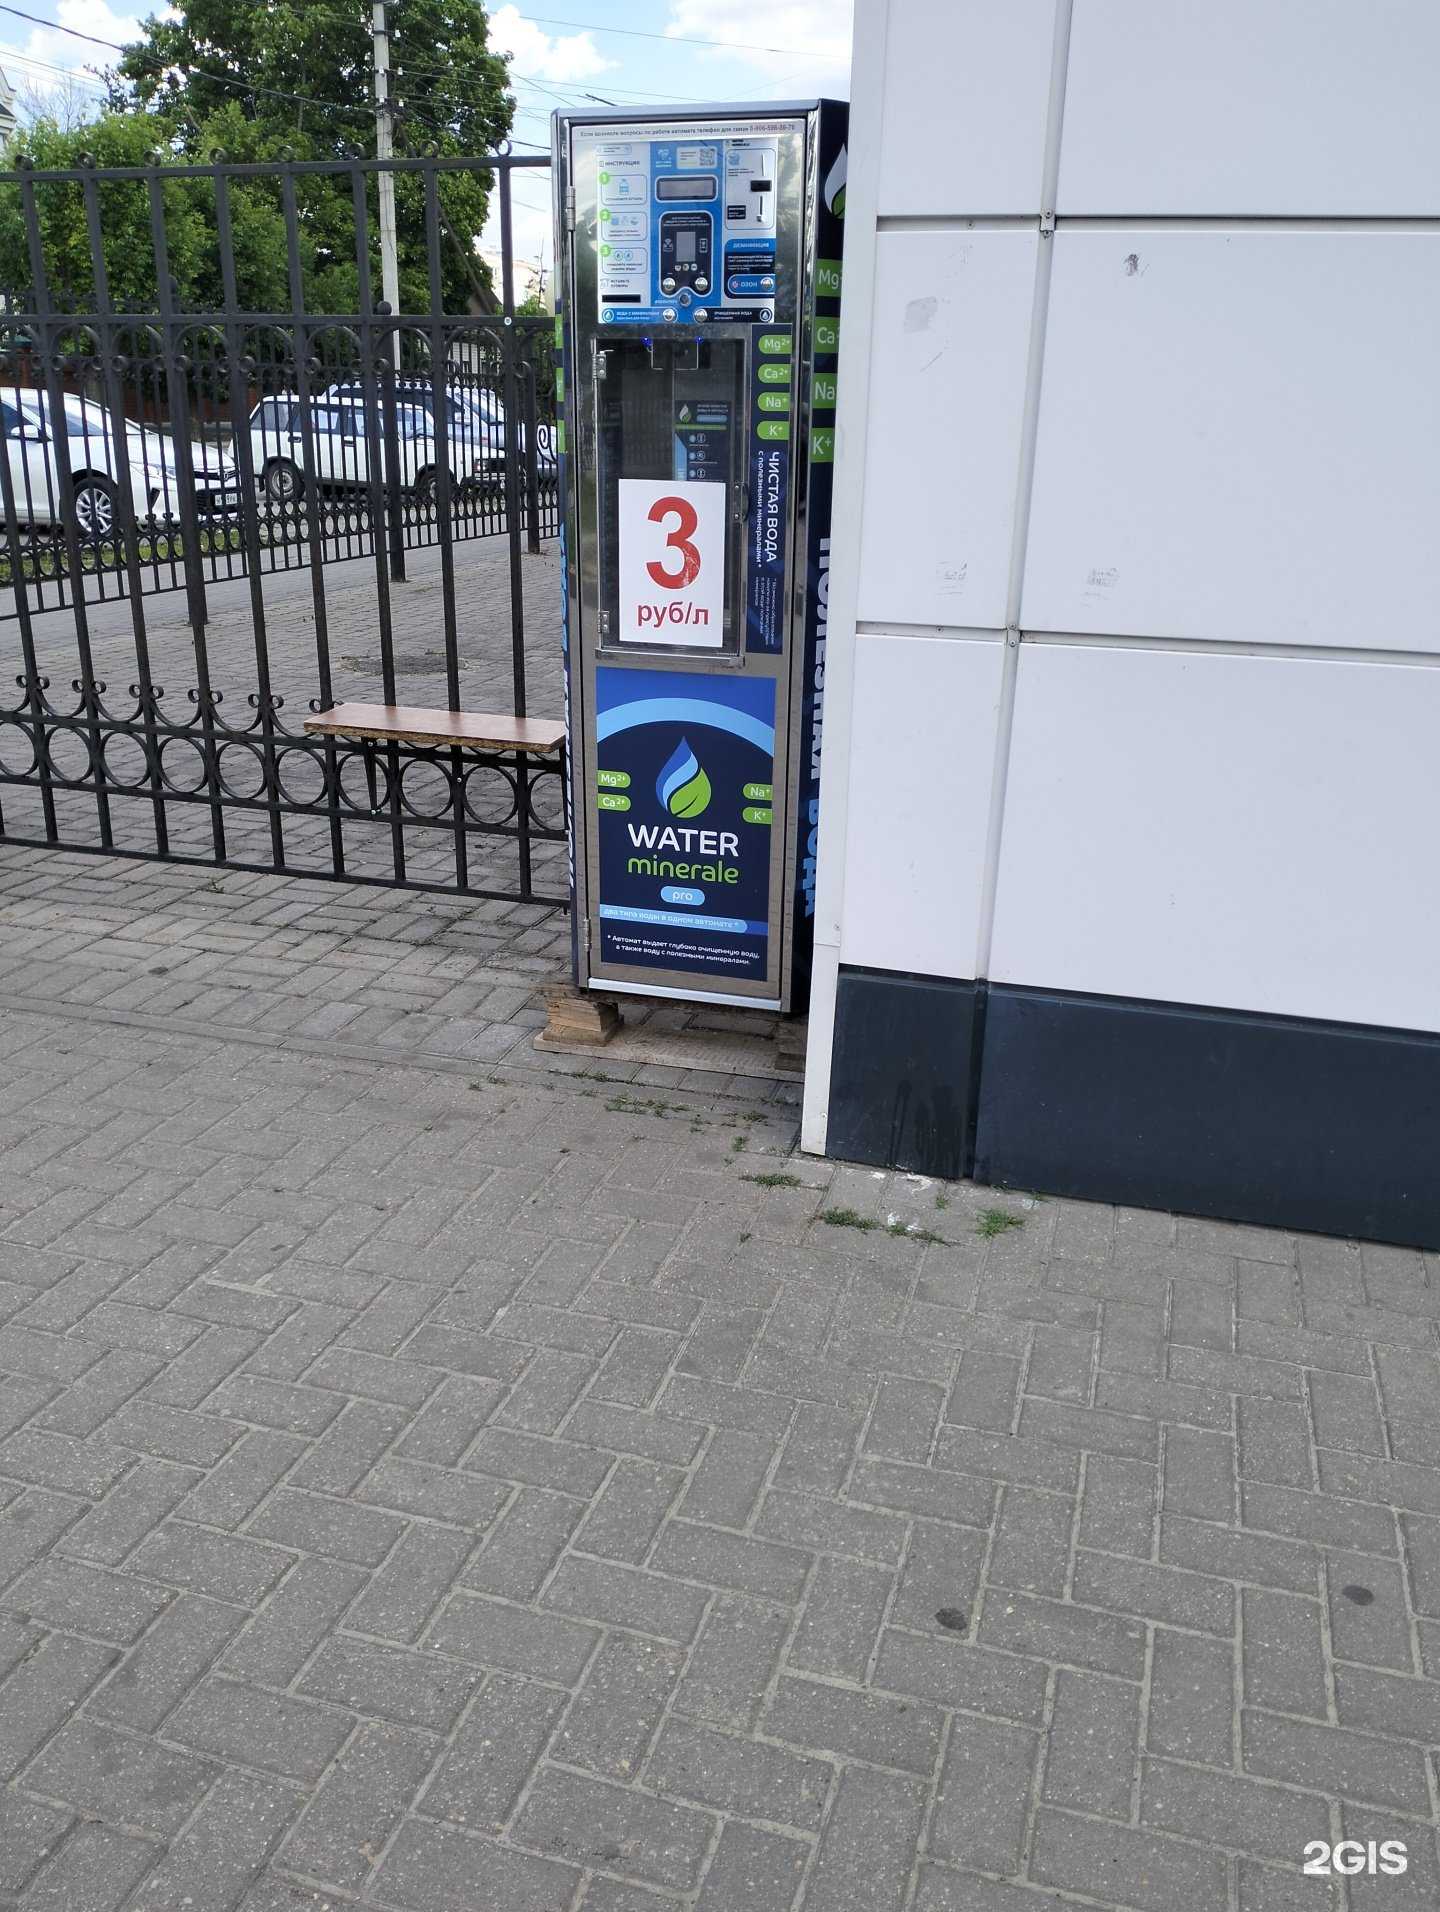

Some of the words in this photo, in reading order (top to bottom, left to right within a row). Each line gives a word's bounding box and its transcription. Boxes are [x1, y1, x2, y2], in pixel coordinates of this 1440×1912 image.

[768, 452, 780, 514] ЧИСТАЯ
[646, 496, 701, 590] 3
[764, 518, 778, 562] ВОДА
[638, 601, 710, 628] руб/л
[628, 824, 739, 856] WATER
[628, 855, 739, 884] minerale
[672, 890, 693, 901] pro
[612, 935, 641, 944] Автомат
[620, 944, 642, 952] также
[644, 947, 660, 956] воду
